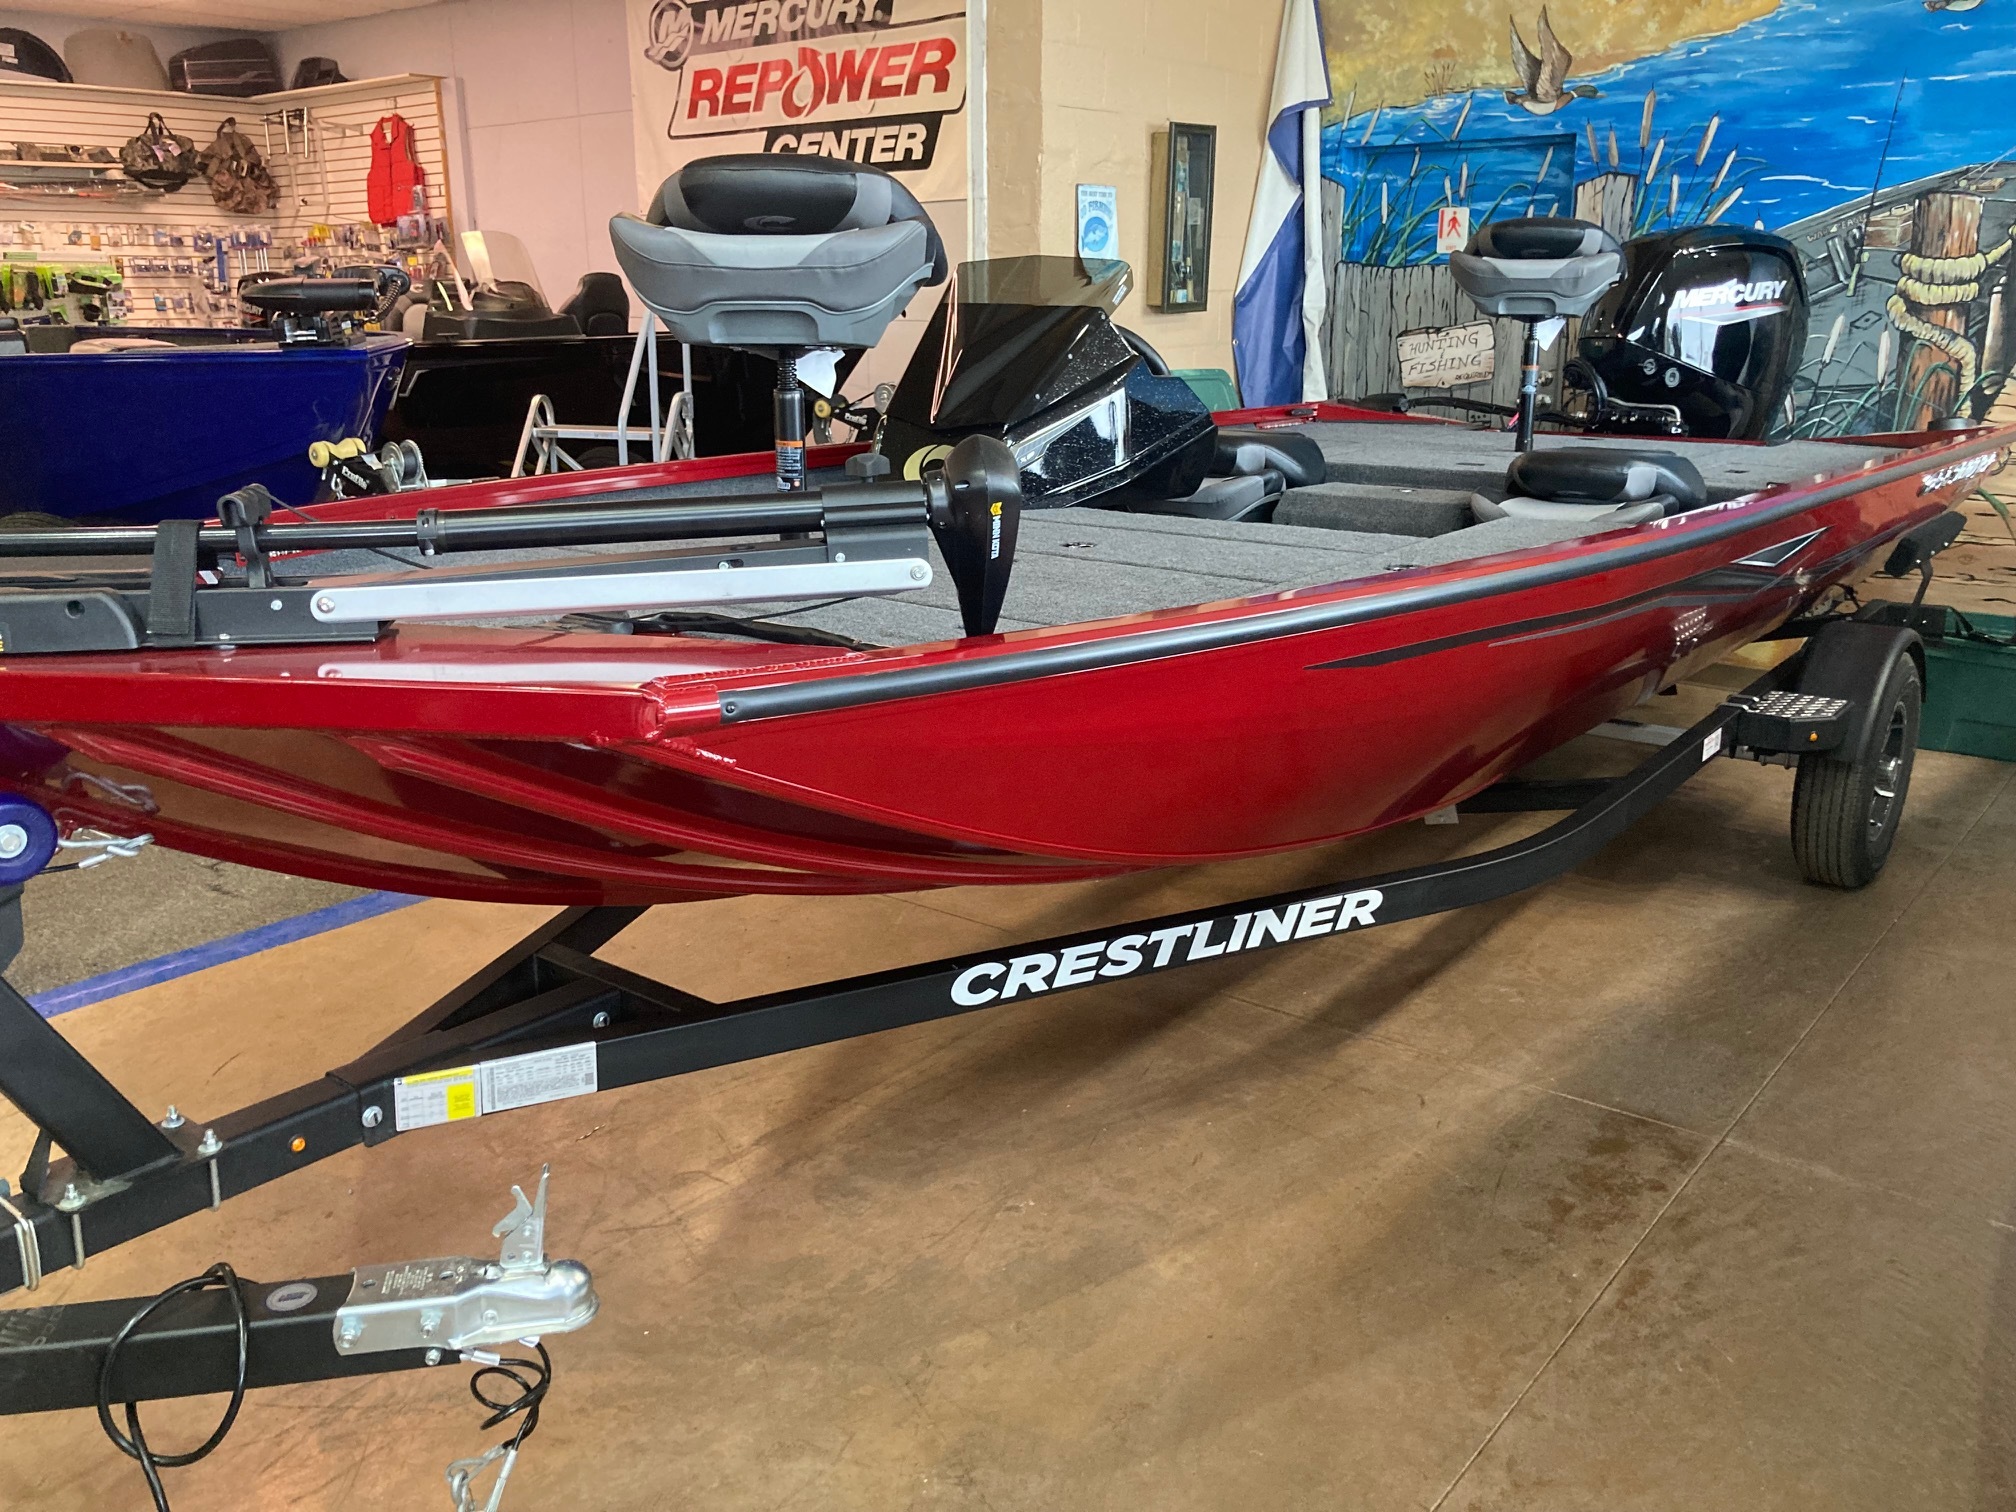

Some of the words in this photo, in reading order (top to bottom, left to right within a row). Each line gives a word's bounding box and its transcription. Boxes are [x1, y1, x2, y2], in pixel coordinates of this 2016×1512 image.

[701, 0, 881, 45] MERCURY
[687, 37, 957, 119] REPOWER
[1671, 280, 1787, 309] MERCURY
[1408, 330, 1479, 355] HUNTING
[1408, 353, 1482, 376] FISHING
[992, 515, 1002, 538] MINN
[991, 538, 1000, 560] KOTA
[950, 888, 1384, 1007] CRESTLINER
